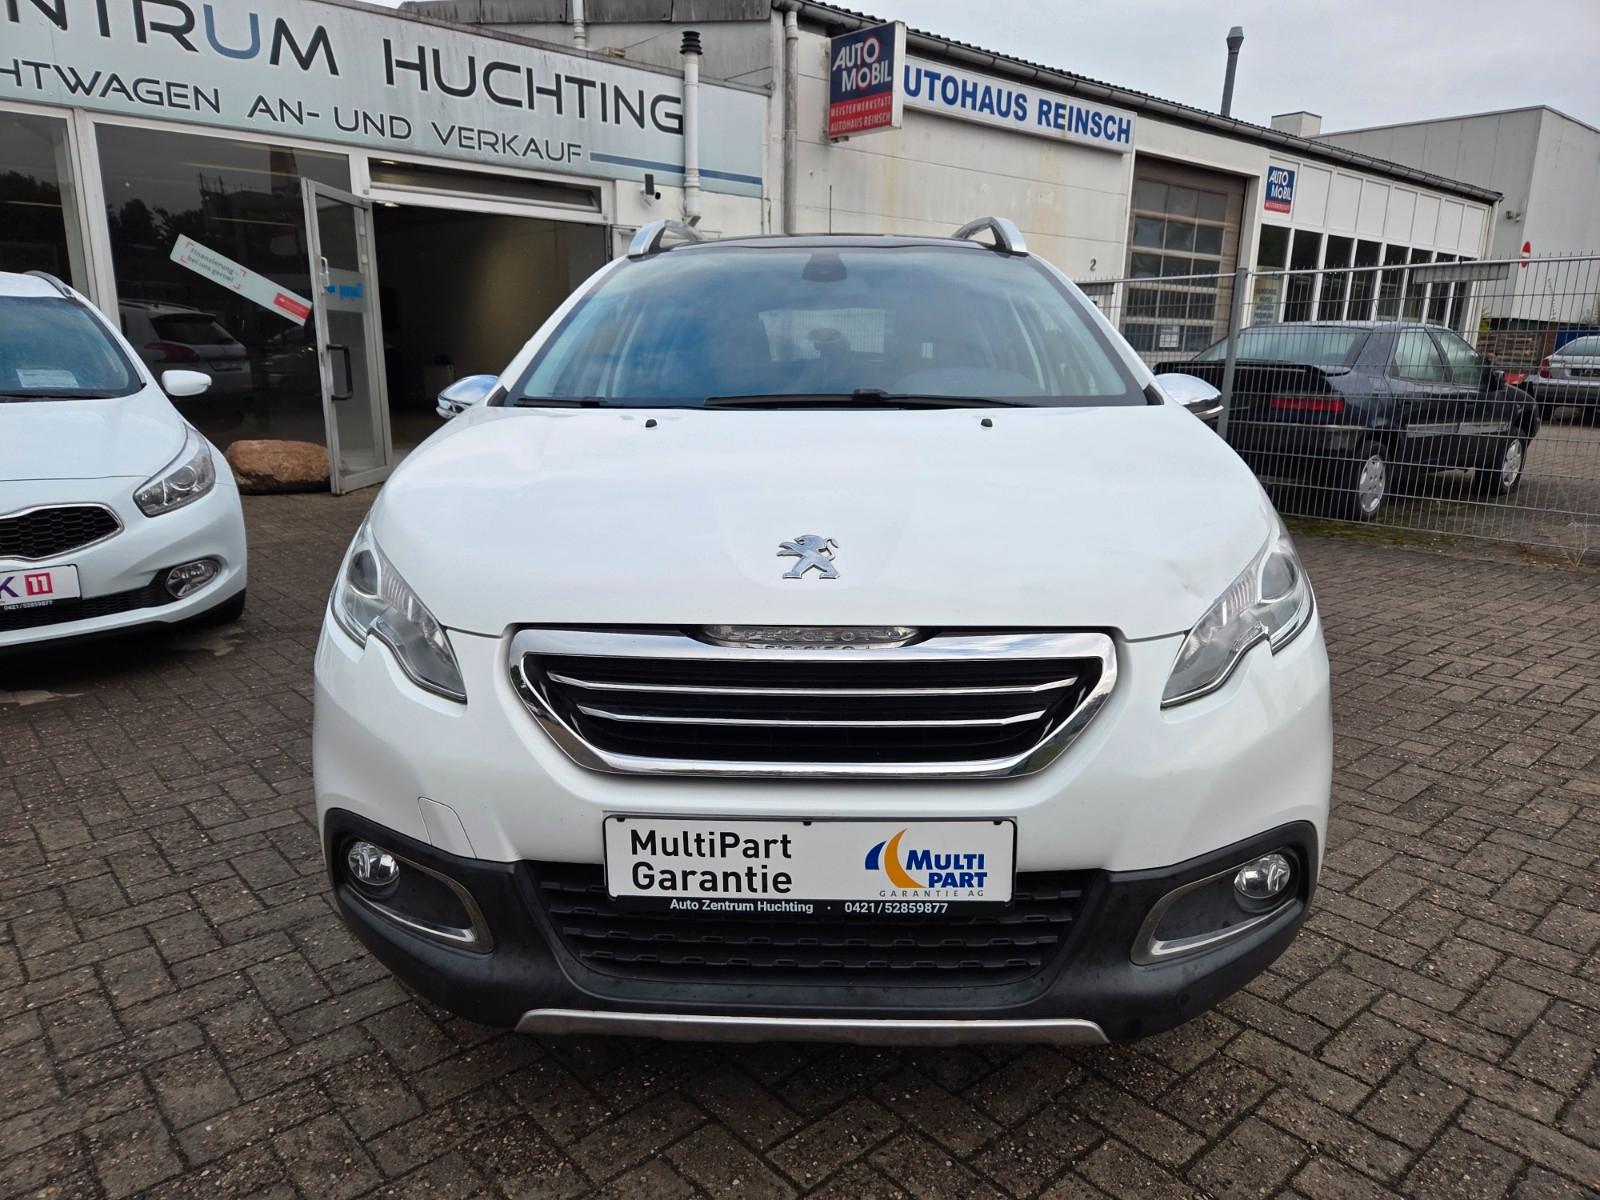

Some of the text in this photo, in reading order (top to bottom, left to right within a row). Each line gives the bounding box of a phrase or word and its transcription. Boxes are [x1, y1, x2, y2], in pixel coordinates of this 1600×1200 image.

[832, 37, 879, 71] AUTO
[842, 60, 892, 92] MOBIL
[383, 38, 684, 136] HUCHTING
[903, 65, 1132, 145] UTOHAUS REINSCH
[864, 111, 891, 126] REINSCH
[247, 95, 320, 126] AN-
[334, 106, 412, 140] UND
[431, 121, 582, 163] VERKAUF
[1268, 170, 1288, 185] AUTO
[1270, 184, 1292, 200] MOBIL
[1089, 258, 1097, 271] 2
[744, 630, 871, 641] PEUGEOT
[630, 829, 792, 859] MultiPart
[906, 849, 985, 870] MULTI
[632, 861, 792, 893] Garantie
[928, 872, 987, 888] PART
[879, 889, 984, 897] GARANTIE AG
[670, 899, 949, 914] Auto Zentrum Huchting 0421/52859877
